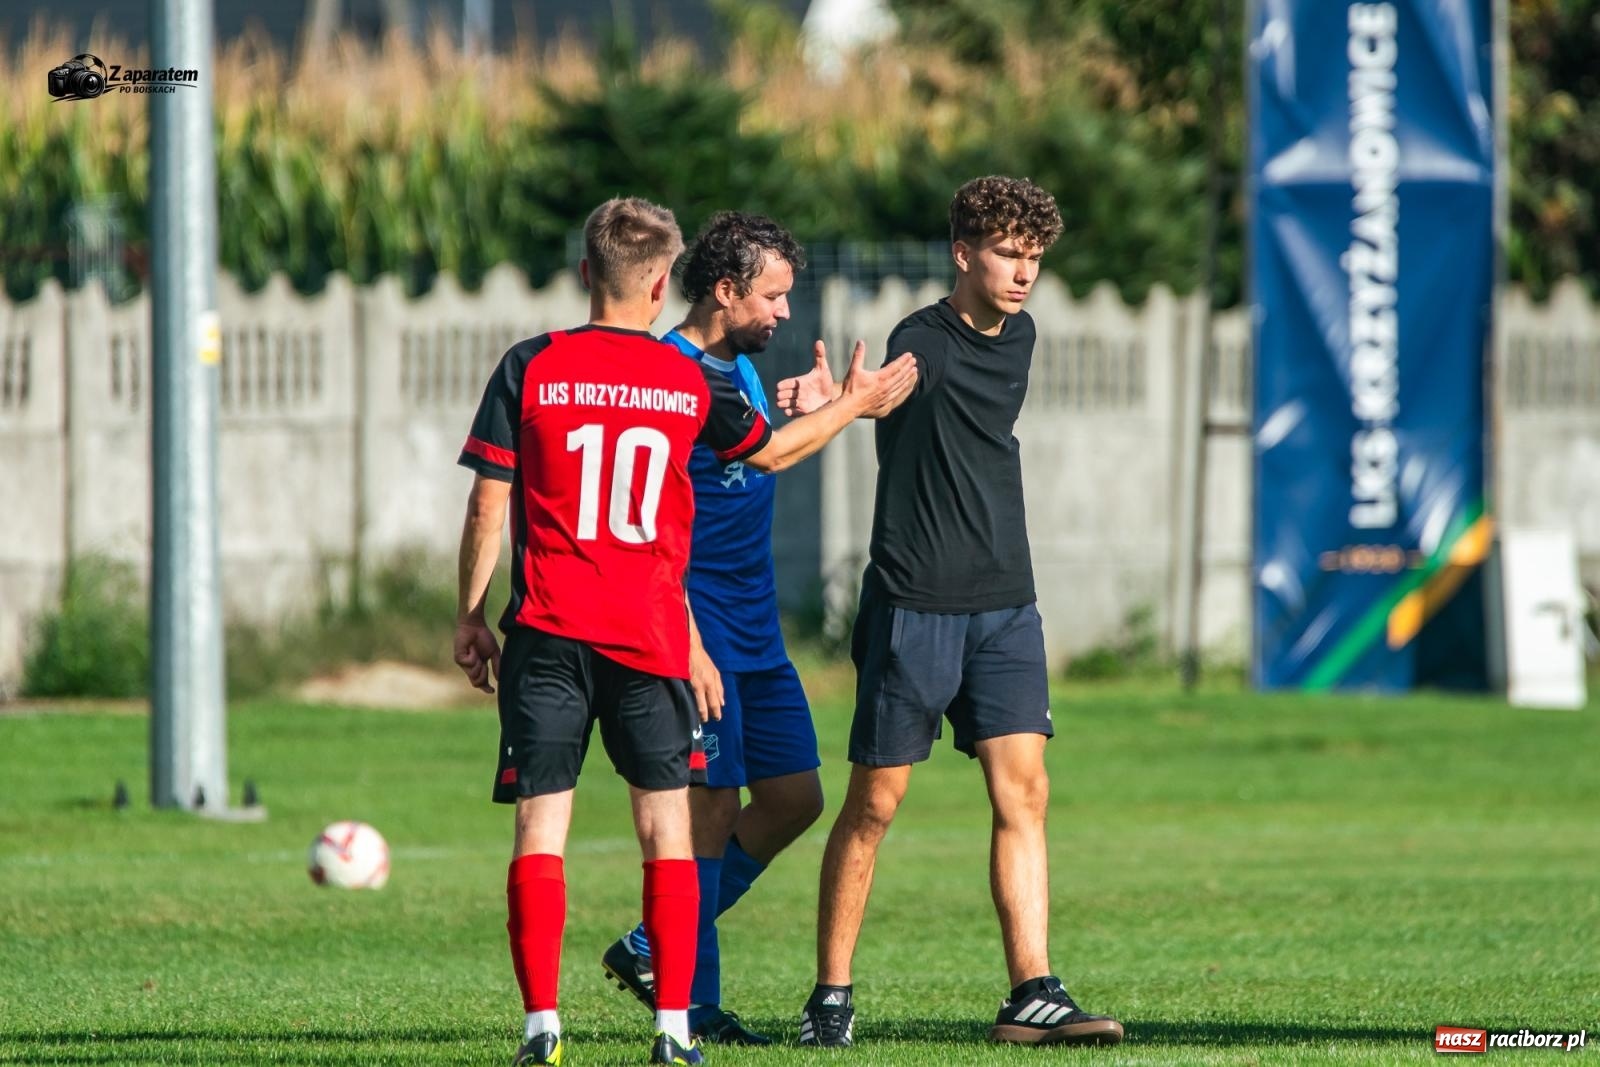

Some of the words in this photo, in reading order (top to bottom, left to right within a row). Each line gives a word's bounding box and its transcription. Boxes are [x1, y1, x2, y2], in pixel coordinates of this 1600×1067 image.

[538, 381, 569, 406] LKS
[574, 381, 699, 417] KRZYŻANOWICE
[566, 423, 671, 544] 10
[1349, 428, 1398, 529] LKS
